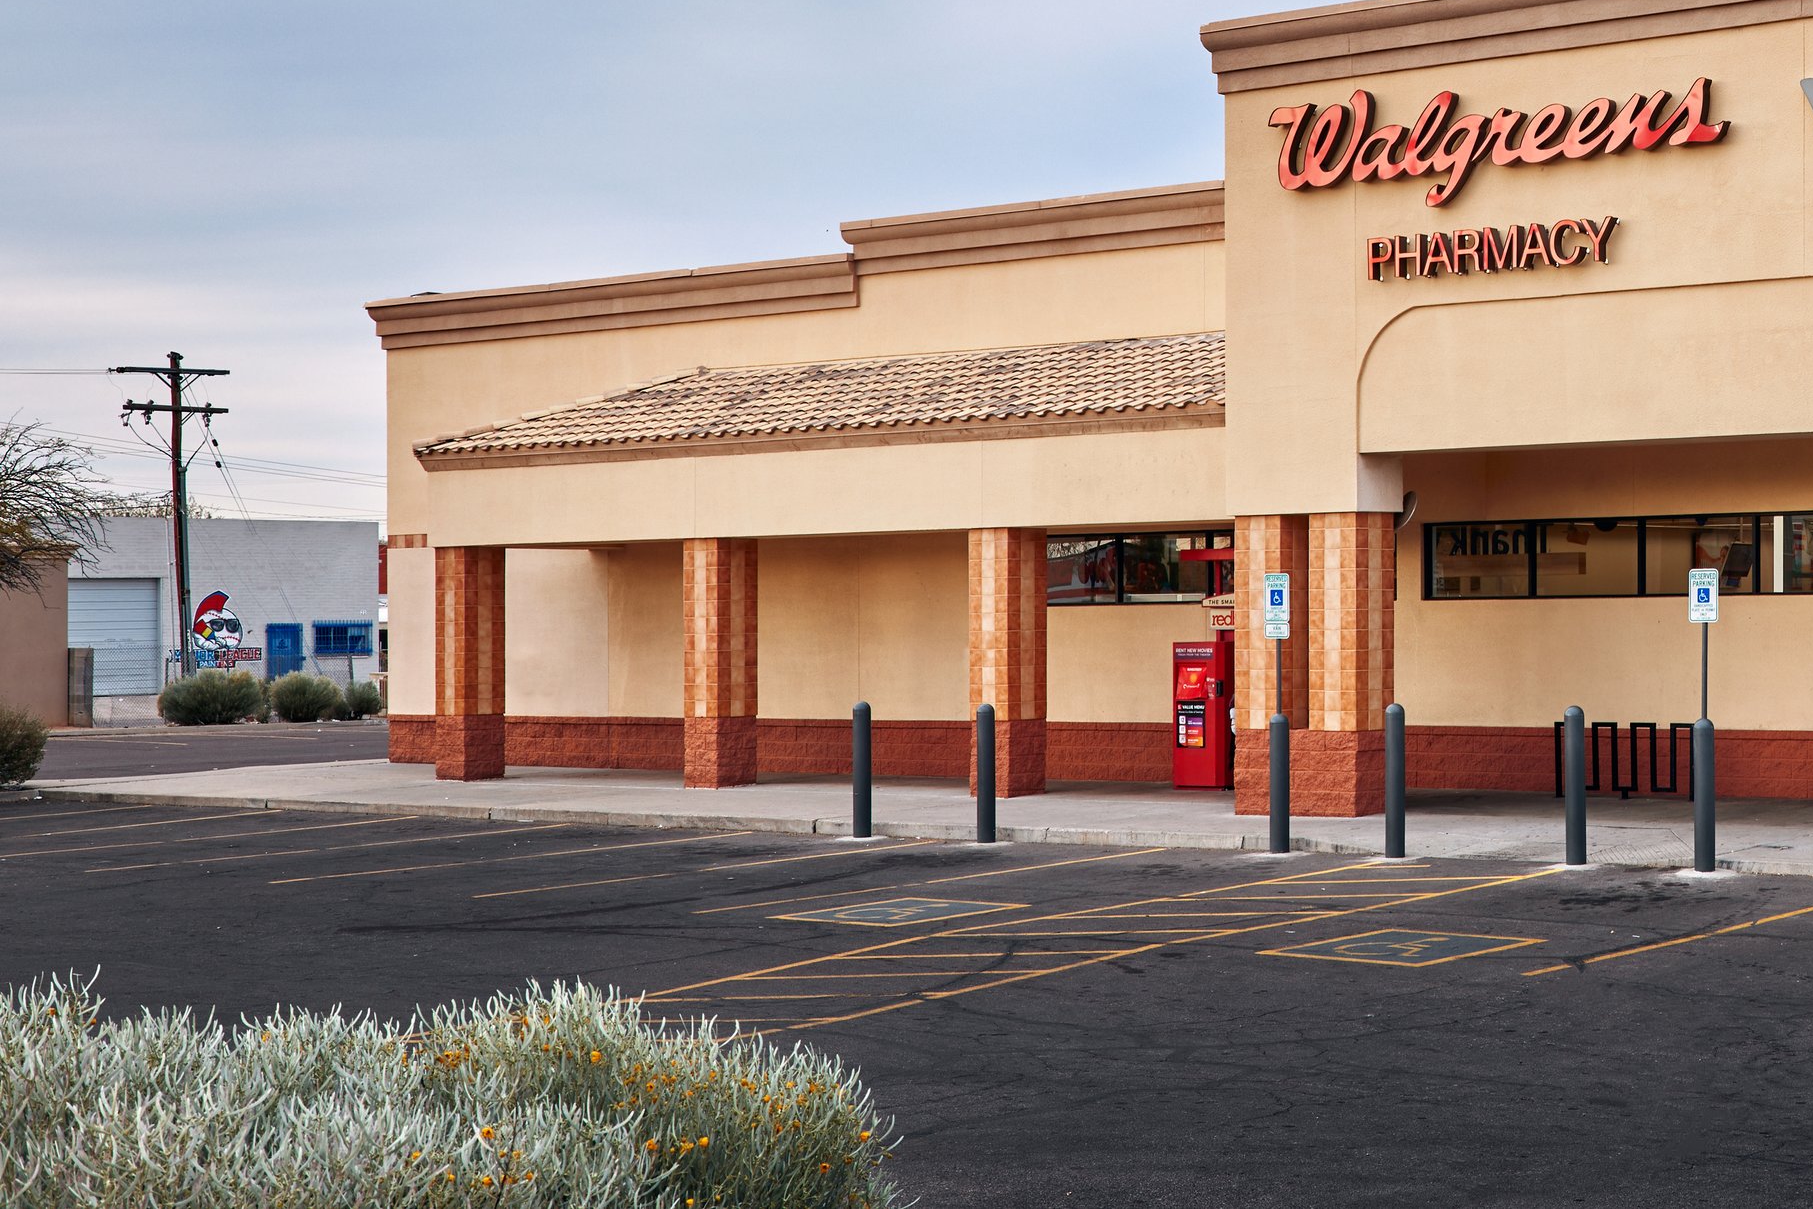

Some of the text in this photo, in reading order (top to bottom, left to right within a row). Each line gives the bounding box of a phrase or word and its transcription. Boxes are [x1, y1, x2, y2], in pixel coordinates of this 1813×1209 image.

[1269, 77, 1731, 207] Walgreens
[1367, 215, 1620, 281] PHARMACY
[1691, 572, 1716, 580] RESERVED
[219, 648, 261, 660] LEAGUE
